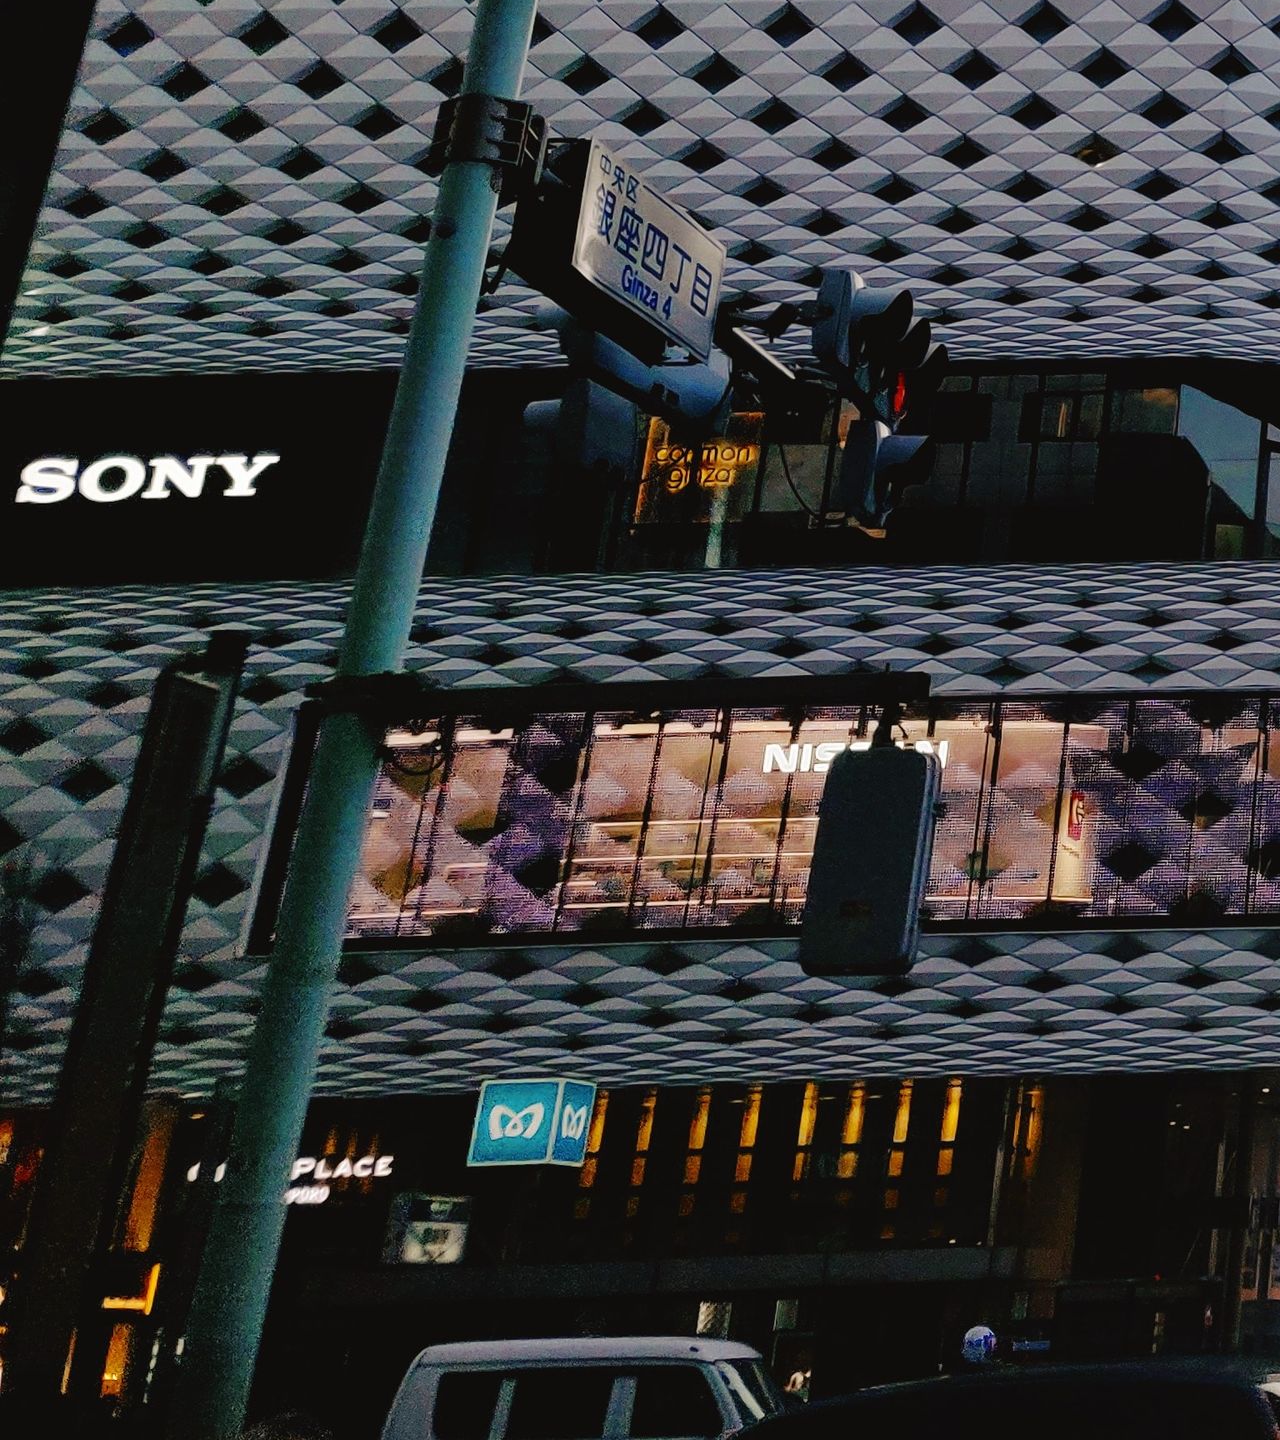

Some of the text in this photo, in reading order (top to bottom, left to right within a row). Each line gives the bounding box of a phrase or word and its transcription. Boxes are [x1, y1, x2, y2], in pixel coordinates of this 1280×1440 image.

[601, 154, 639, 203] 中央区
[597, 185, 712, 317] 銀座四丁目
[621, 264, 673, 320] Ginza 4
[15, 455, 280, 504] SONY
[763, 741, 949, 774] NISN
[290, 1156, 394, 1181] PLACE
